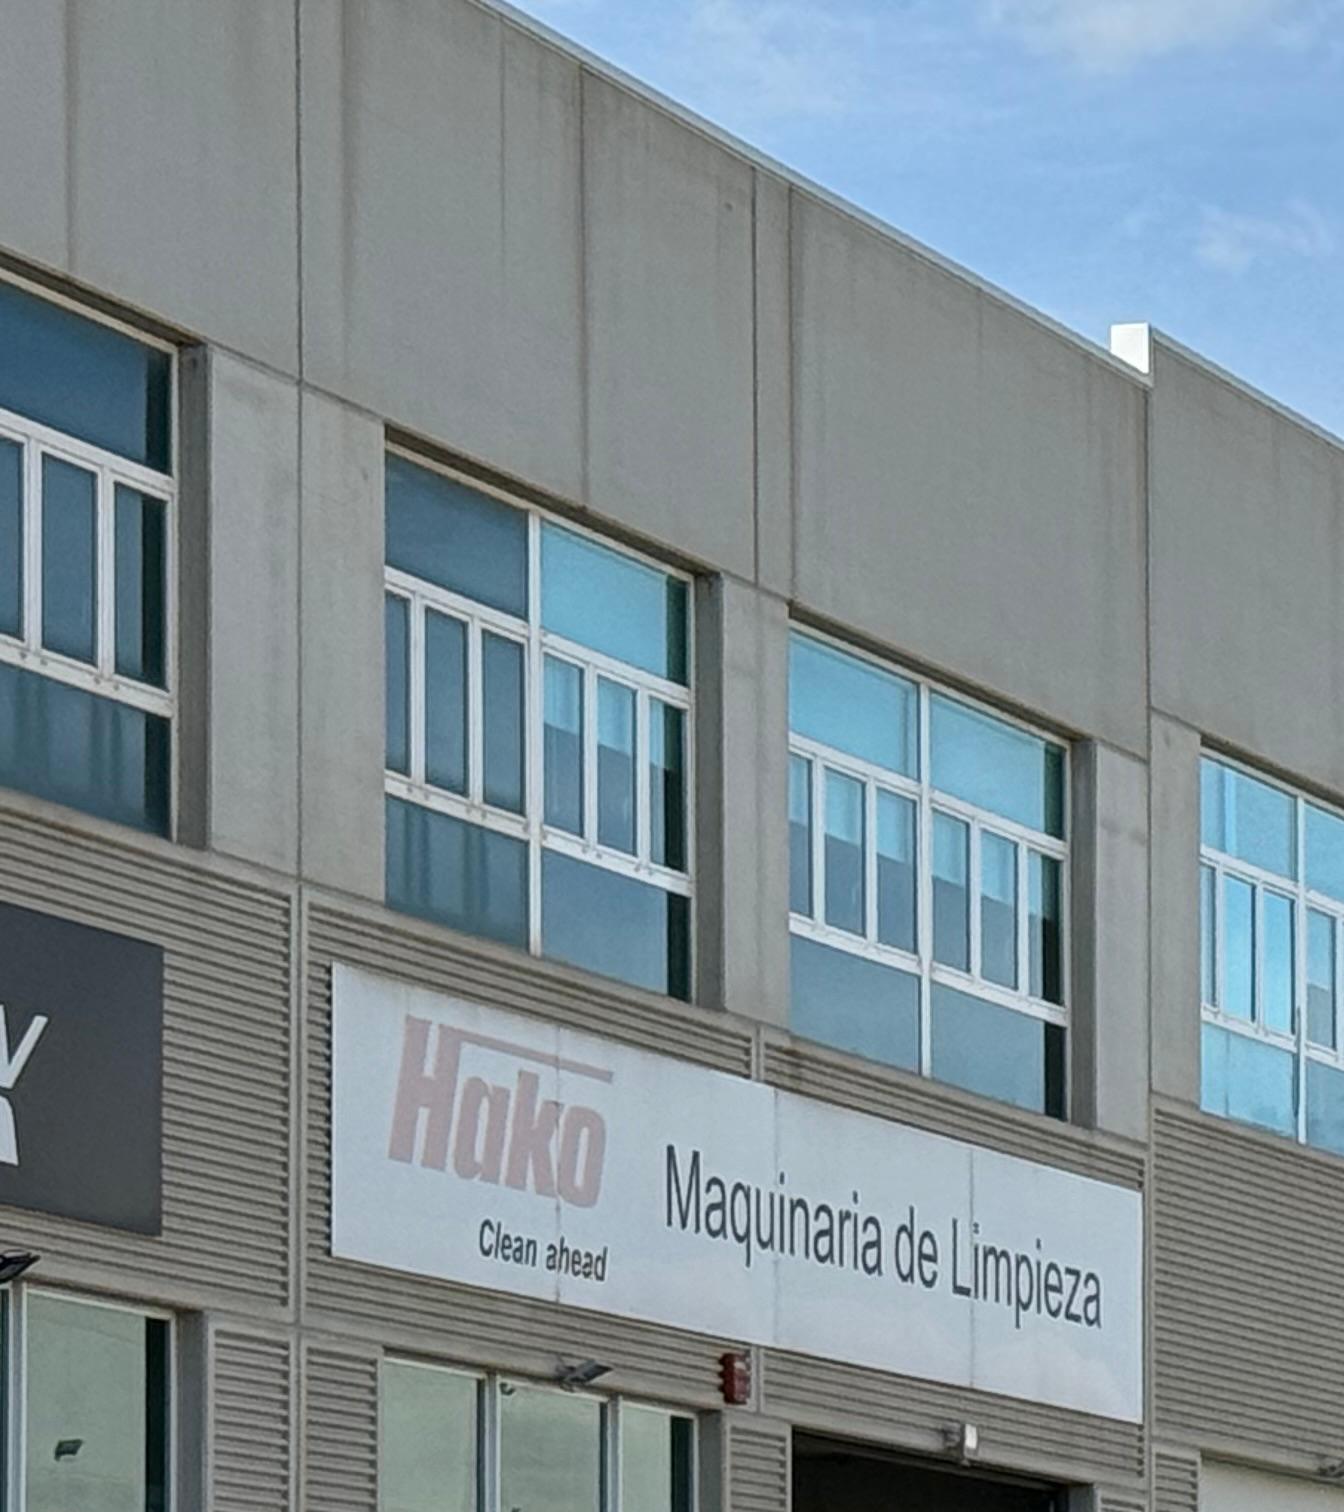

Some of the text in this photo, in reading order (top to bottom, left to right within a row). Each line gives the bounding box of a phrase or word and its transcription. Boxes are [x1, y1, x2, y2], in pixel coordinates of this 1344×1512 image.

[388, 1013, 613, 1209] Hako
[479, 1218, 608, 1282] Clean ahead
[664, 1144, 1102, 1329] Maquinaria de Limpieza
